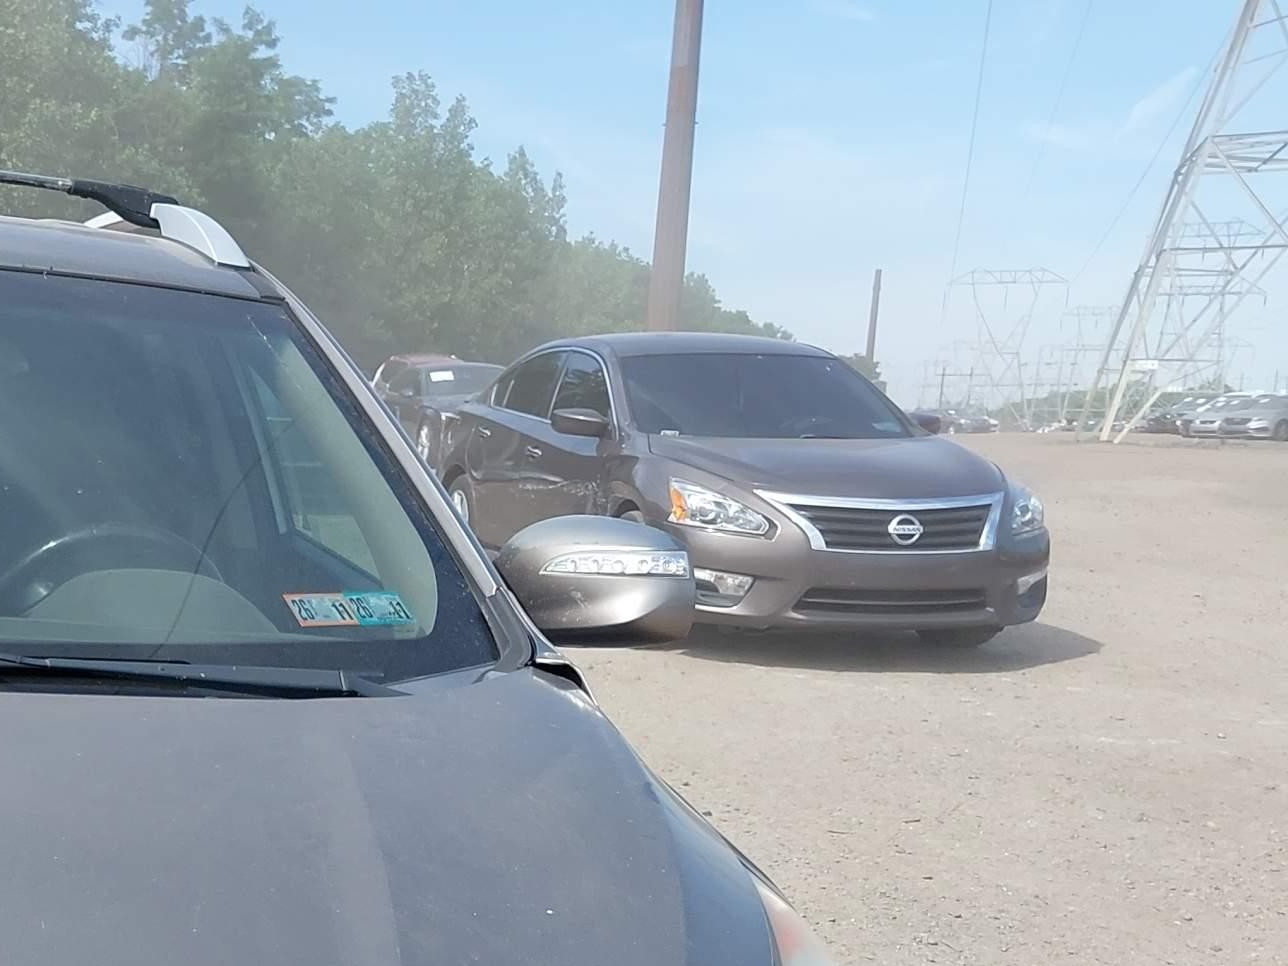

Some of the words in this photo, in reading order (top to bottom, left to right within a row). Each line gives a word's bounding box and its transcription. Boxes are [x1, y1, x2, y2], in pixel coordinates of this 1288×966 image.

[291, 599, 315, 620] 26
[331, 602, 354, 620] 11
[349, 598, 373, 619] 26
